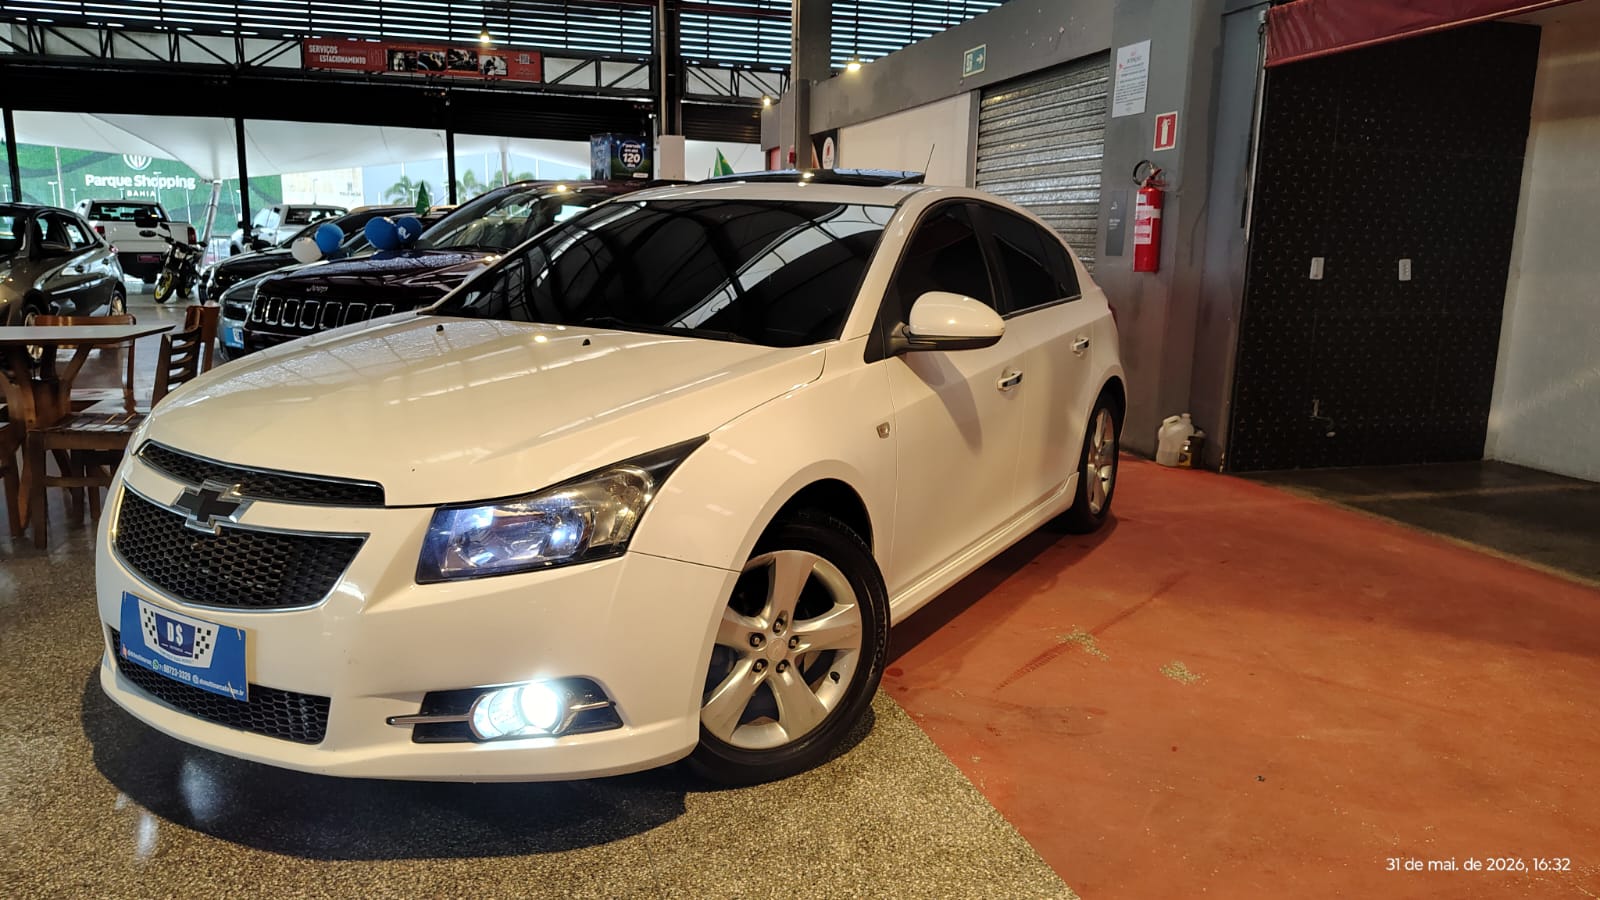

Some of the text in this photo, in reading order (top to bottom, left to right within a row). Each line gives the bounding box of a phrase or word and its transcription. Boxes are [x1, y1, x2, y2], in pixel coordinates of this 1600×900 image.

[319, 54, 366, 65] ESTACIONAMENTO
[622, 153, 641, 163] 120
[84, 174, 196, 190] Parque Shopping
